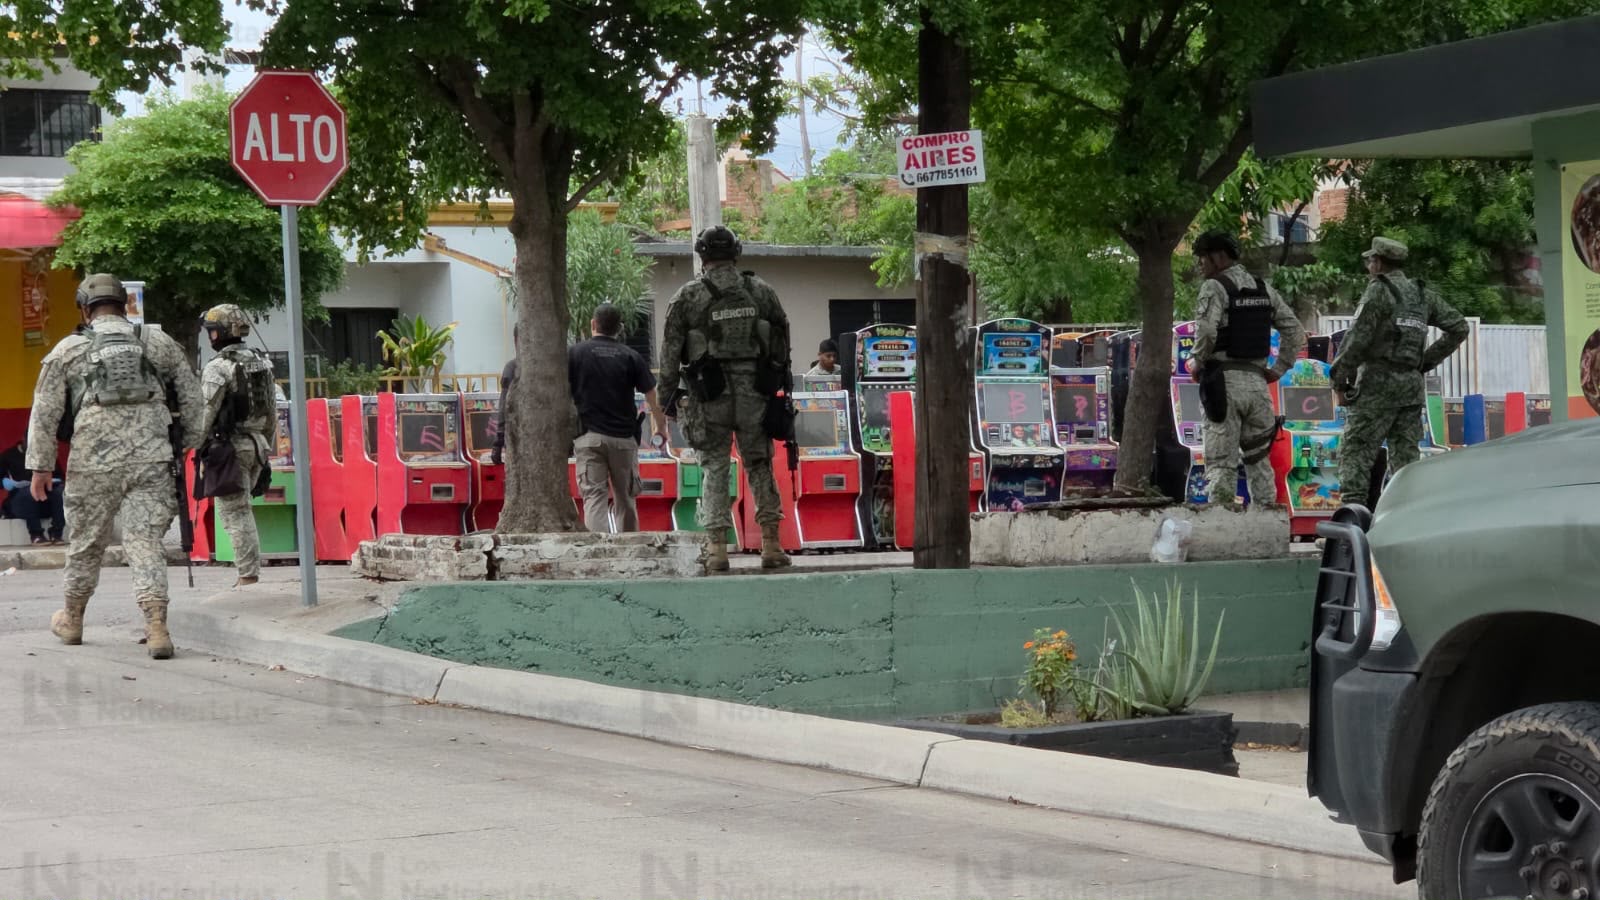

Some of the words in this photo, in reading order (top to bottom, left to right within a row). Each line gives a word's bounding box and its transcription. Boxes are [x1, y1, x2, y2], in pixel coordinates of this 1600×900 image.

[243, 112, 338, 163] ALTO
[902, 132, 970, 150] COMPRO
[904, 145, 977, 171] AIRES
[916, 165, 978, 183] 6677851161
[1555, 751, 1600, 786] COO
